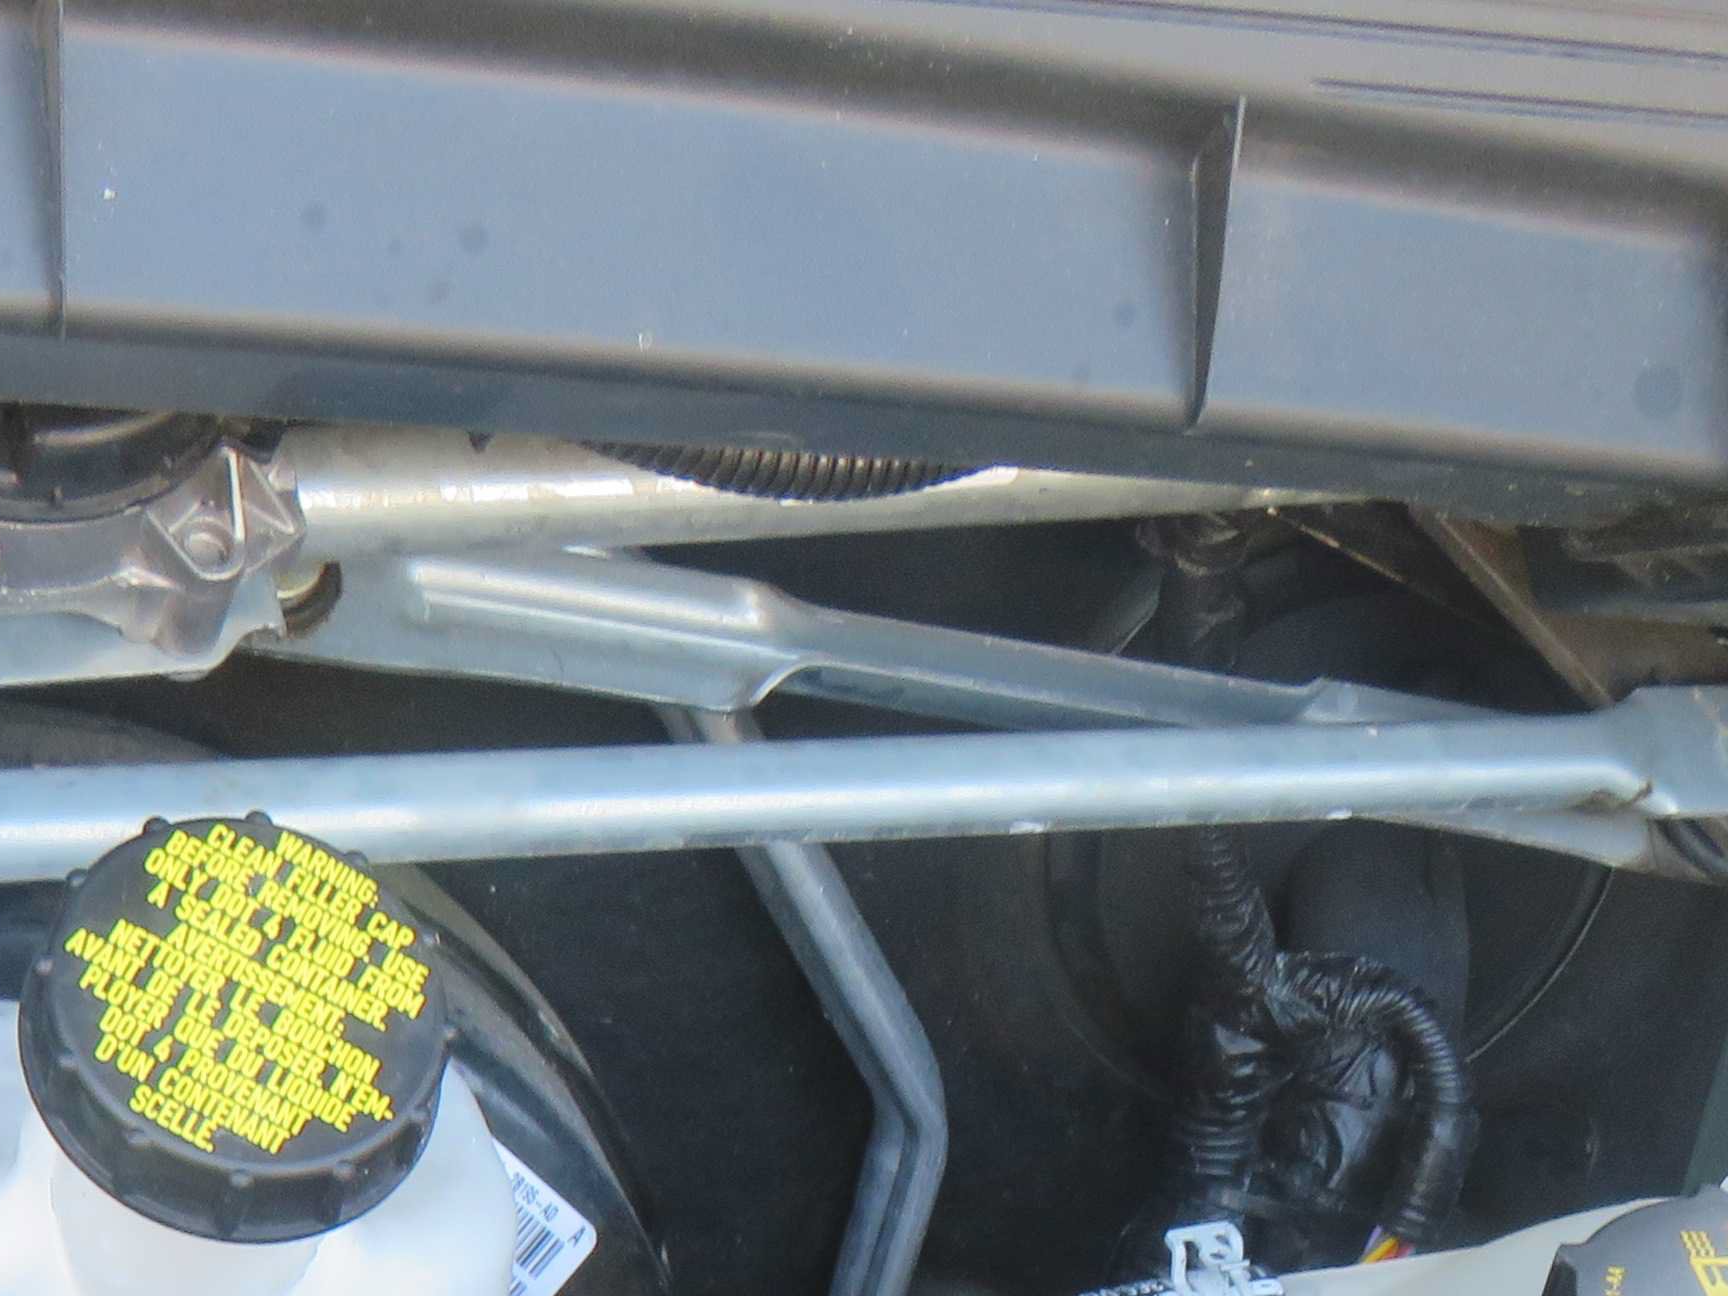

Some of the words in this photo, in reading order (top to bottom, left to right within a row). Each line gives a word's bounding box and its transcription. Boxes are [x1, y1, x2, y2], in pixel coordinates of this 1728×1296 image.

[142, 847, 208, 898] ONLY
[207, 882, 259, 925] DOT
[259, 912, 286, 940] 4
[285, 926, 357, 979] FLUID
[355, 965, 427, 1020] FROM
[164, 829, 255, 894] BEFORE
[254, 879, 379, 962] REMOVING.
[379, 948, 432, 992] USE
[204, 822, 283, 880] CLEAN
[283, 865, 364, 924] FILLER
[364, 910, 417, 954] CAP
[273, 830, 381, 907] WARNING:
[64, 926, 145, 985] AVANT
[144, 969, 185, 1005] DE
[183, 990, 222, 1026] LE
[328, 1071, 400, 1125] N'EM-
[107, 918, 229, 1000] NETTOYER
[227, 984, 267, 1020] LE
[270, 1008, 381, 1084] BOUCHON
[145, 878, 174, 908] A
[172, 893, 264, 958] SEALED
[262, 943, 396, 1031] CONTAINER.
[165, 919, 351, 1037] AVERTISSEMENT:
[78, 963, 172, 1029] PLOYER
[170, 1014, 225, 1058] QUE
[224, 1043, 266, 1080] DU
[264, 1066, 358, 1133] LIQUIDE
[93, 1033, 157, 1083] D'UN
[154, 1066, 291, 1157] CONTENANT
[98, 1005, 151, 1049] DOT
[150, 1033, 178, 1063] 4
[175, 1046, 312, 1137] PROVENANT
